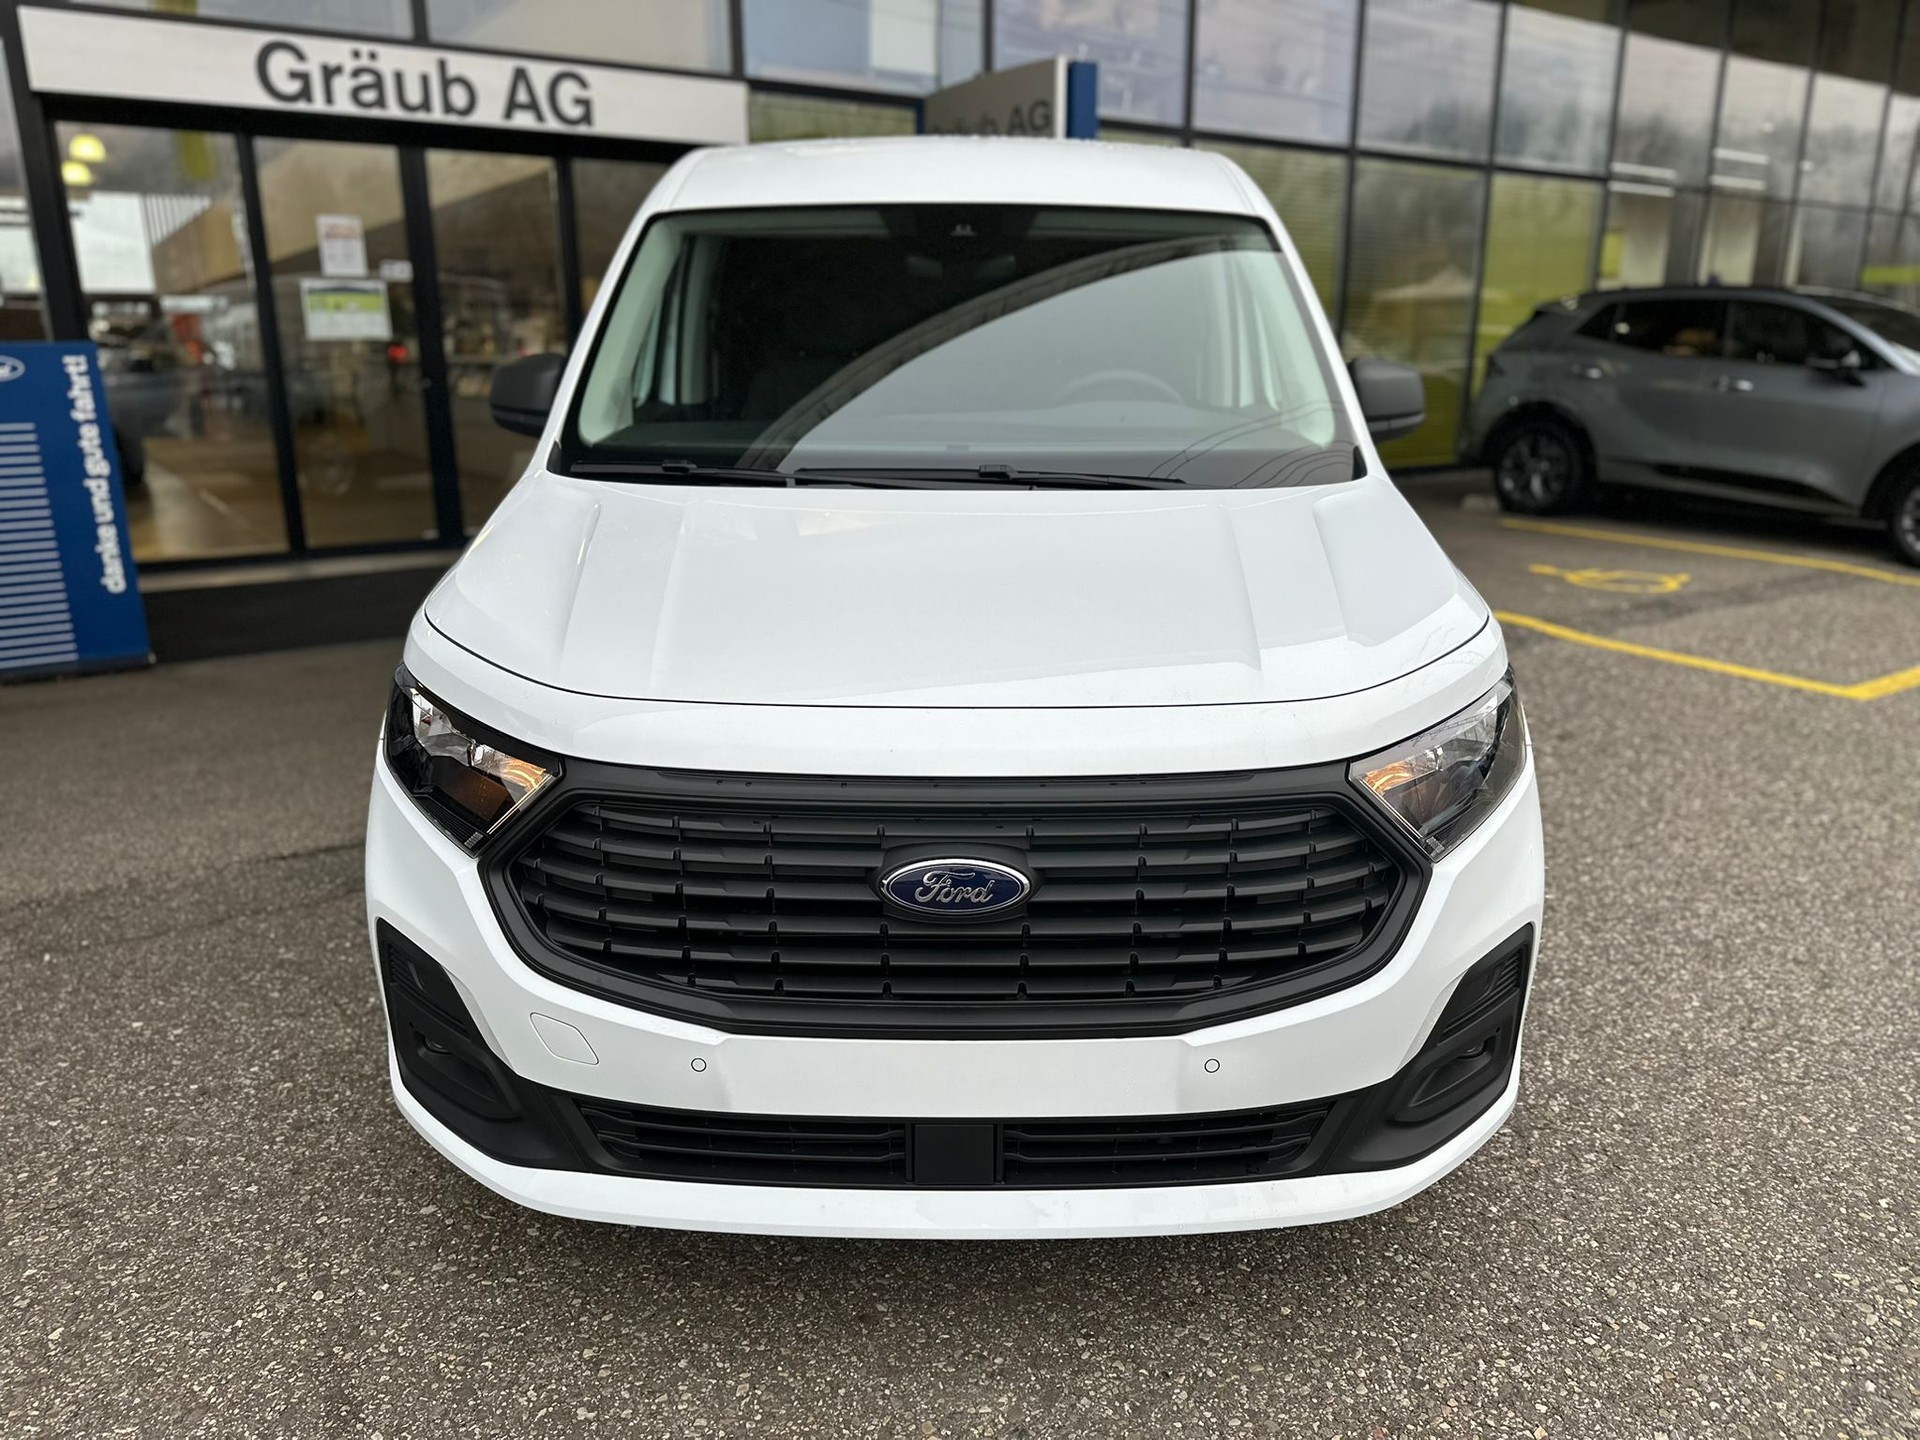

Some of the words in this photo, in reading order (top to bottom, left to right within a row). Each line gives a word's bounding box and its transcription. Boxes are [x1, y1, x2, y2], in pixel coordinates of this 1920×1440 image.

[255, 40, 477, 117] Gräub
[502, 66, 594, 127] AG
[1007, 99, 1051, 135] AG
[78, 421, 111, 477] gute
[83, 477, 114, 524] und
[95, 522, 127, 594] danke
[914, 870, 995, 903] Ford
